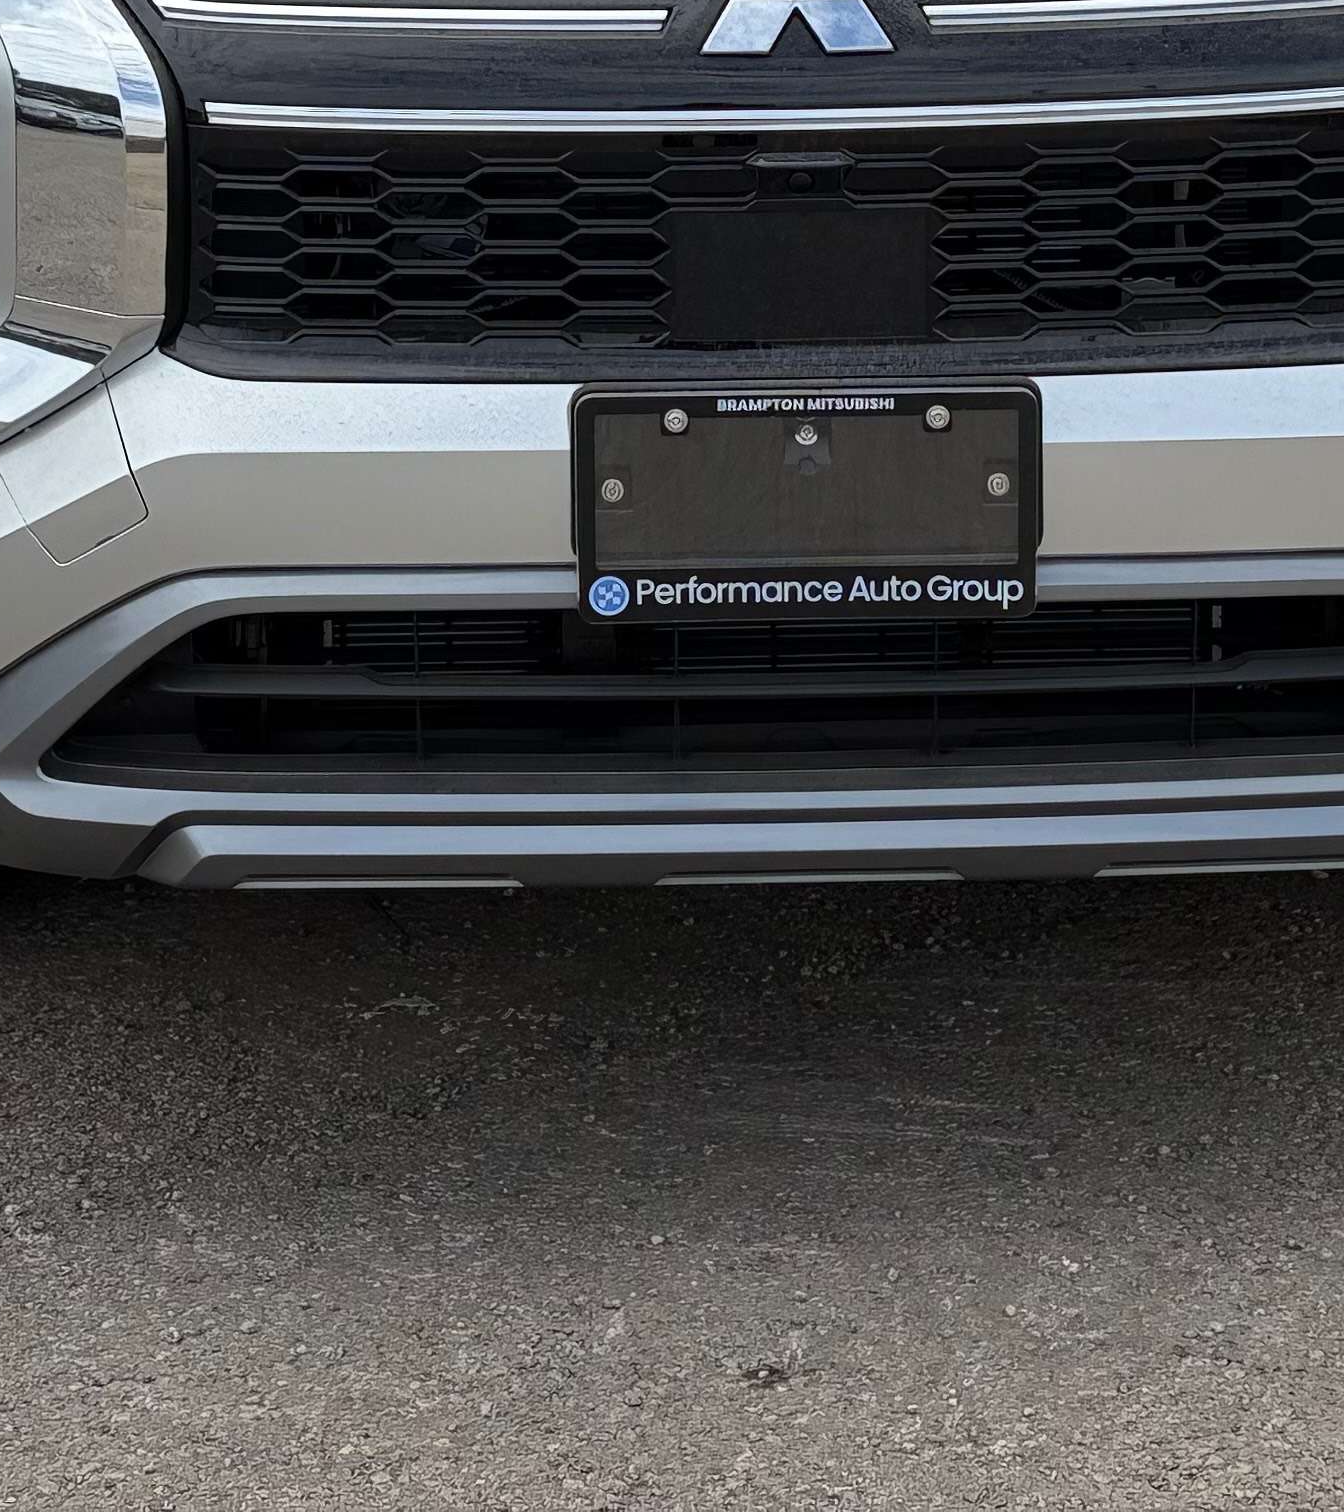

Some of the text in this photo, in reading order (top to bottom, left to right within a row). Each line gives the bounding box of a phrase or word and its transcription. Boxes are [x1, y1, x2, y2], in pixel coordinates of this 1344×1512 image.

[716, 397, 895, 412] BRAMPTON MITSUBISHI
[636, 574, 1024, 610] Performance Auto Group
